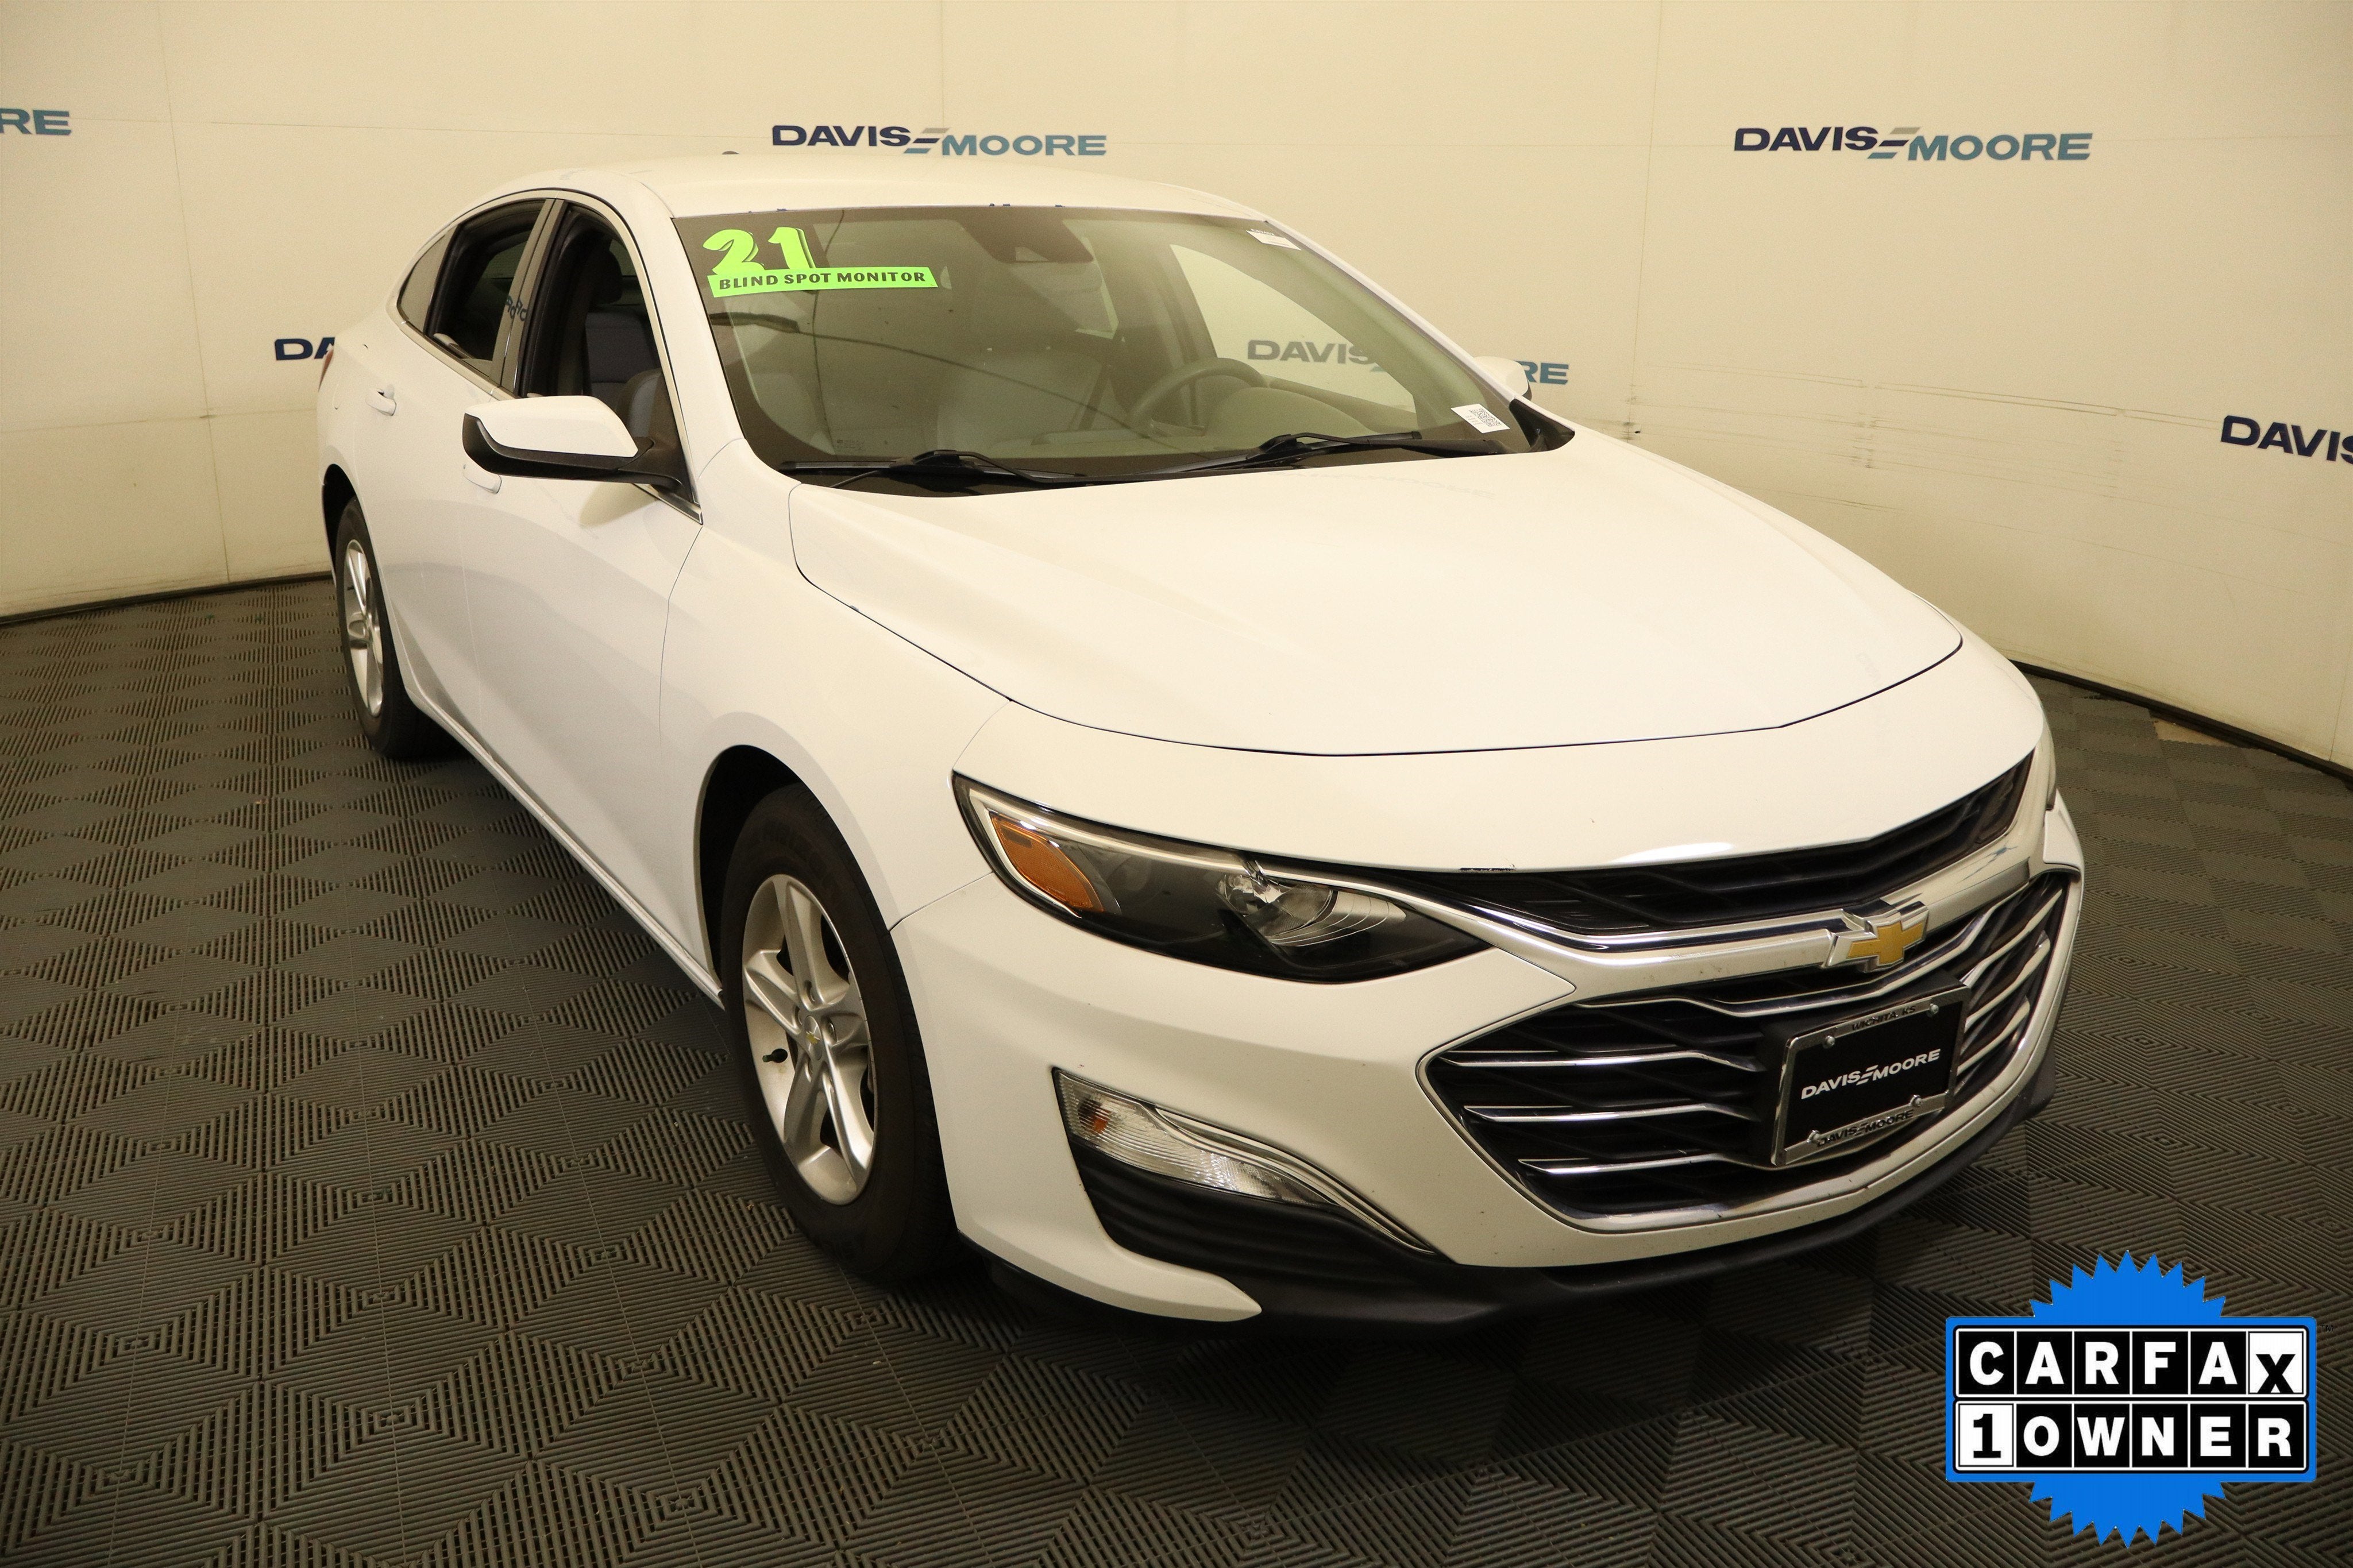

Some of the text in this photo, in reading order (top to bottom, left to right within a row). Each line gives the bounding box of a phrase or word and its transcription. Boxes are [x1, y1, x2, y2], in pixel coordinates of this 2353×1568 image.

[772, 125, 1107, 156] DAVIS MOORE
[1734, 126, 2093, 161] DAVIS MOORE
[702, 227, 816, 275] 21
[719, 272, 926, 289] BLIND SPOT MONITOR
[1247, 339, 1377, 365] DAVIS
[1801, 1048, 1941, 1099] DAVIS MOORE
[1865, 1109, 1914, 1134] MOORE
